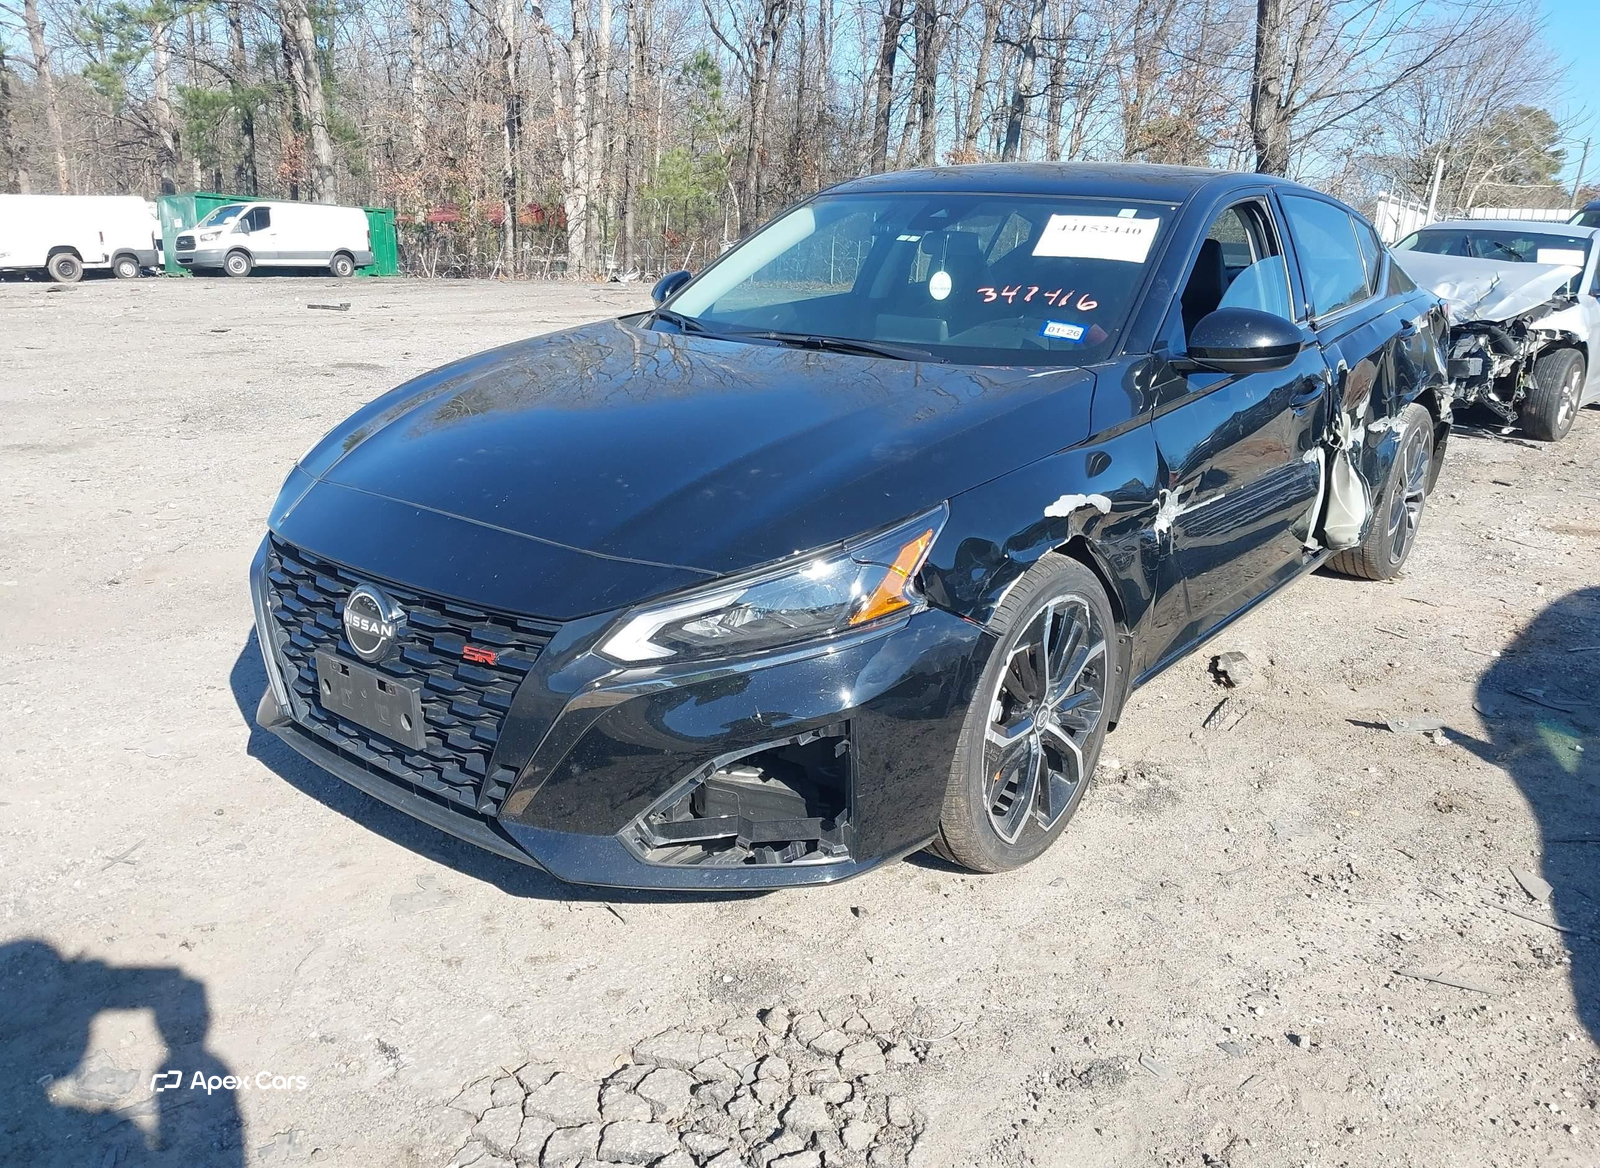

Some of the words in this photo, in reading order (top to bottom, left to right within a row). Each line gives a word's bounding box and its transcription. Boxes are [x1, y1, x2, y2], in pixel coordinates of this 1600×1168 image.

[1057, 224, 1142, 235] 44152440
[344, 606, 393, 637] NISSAN
[462, 645, 497, 666] SR
